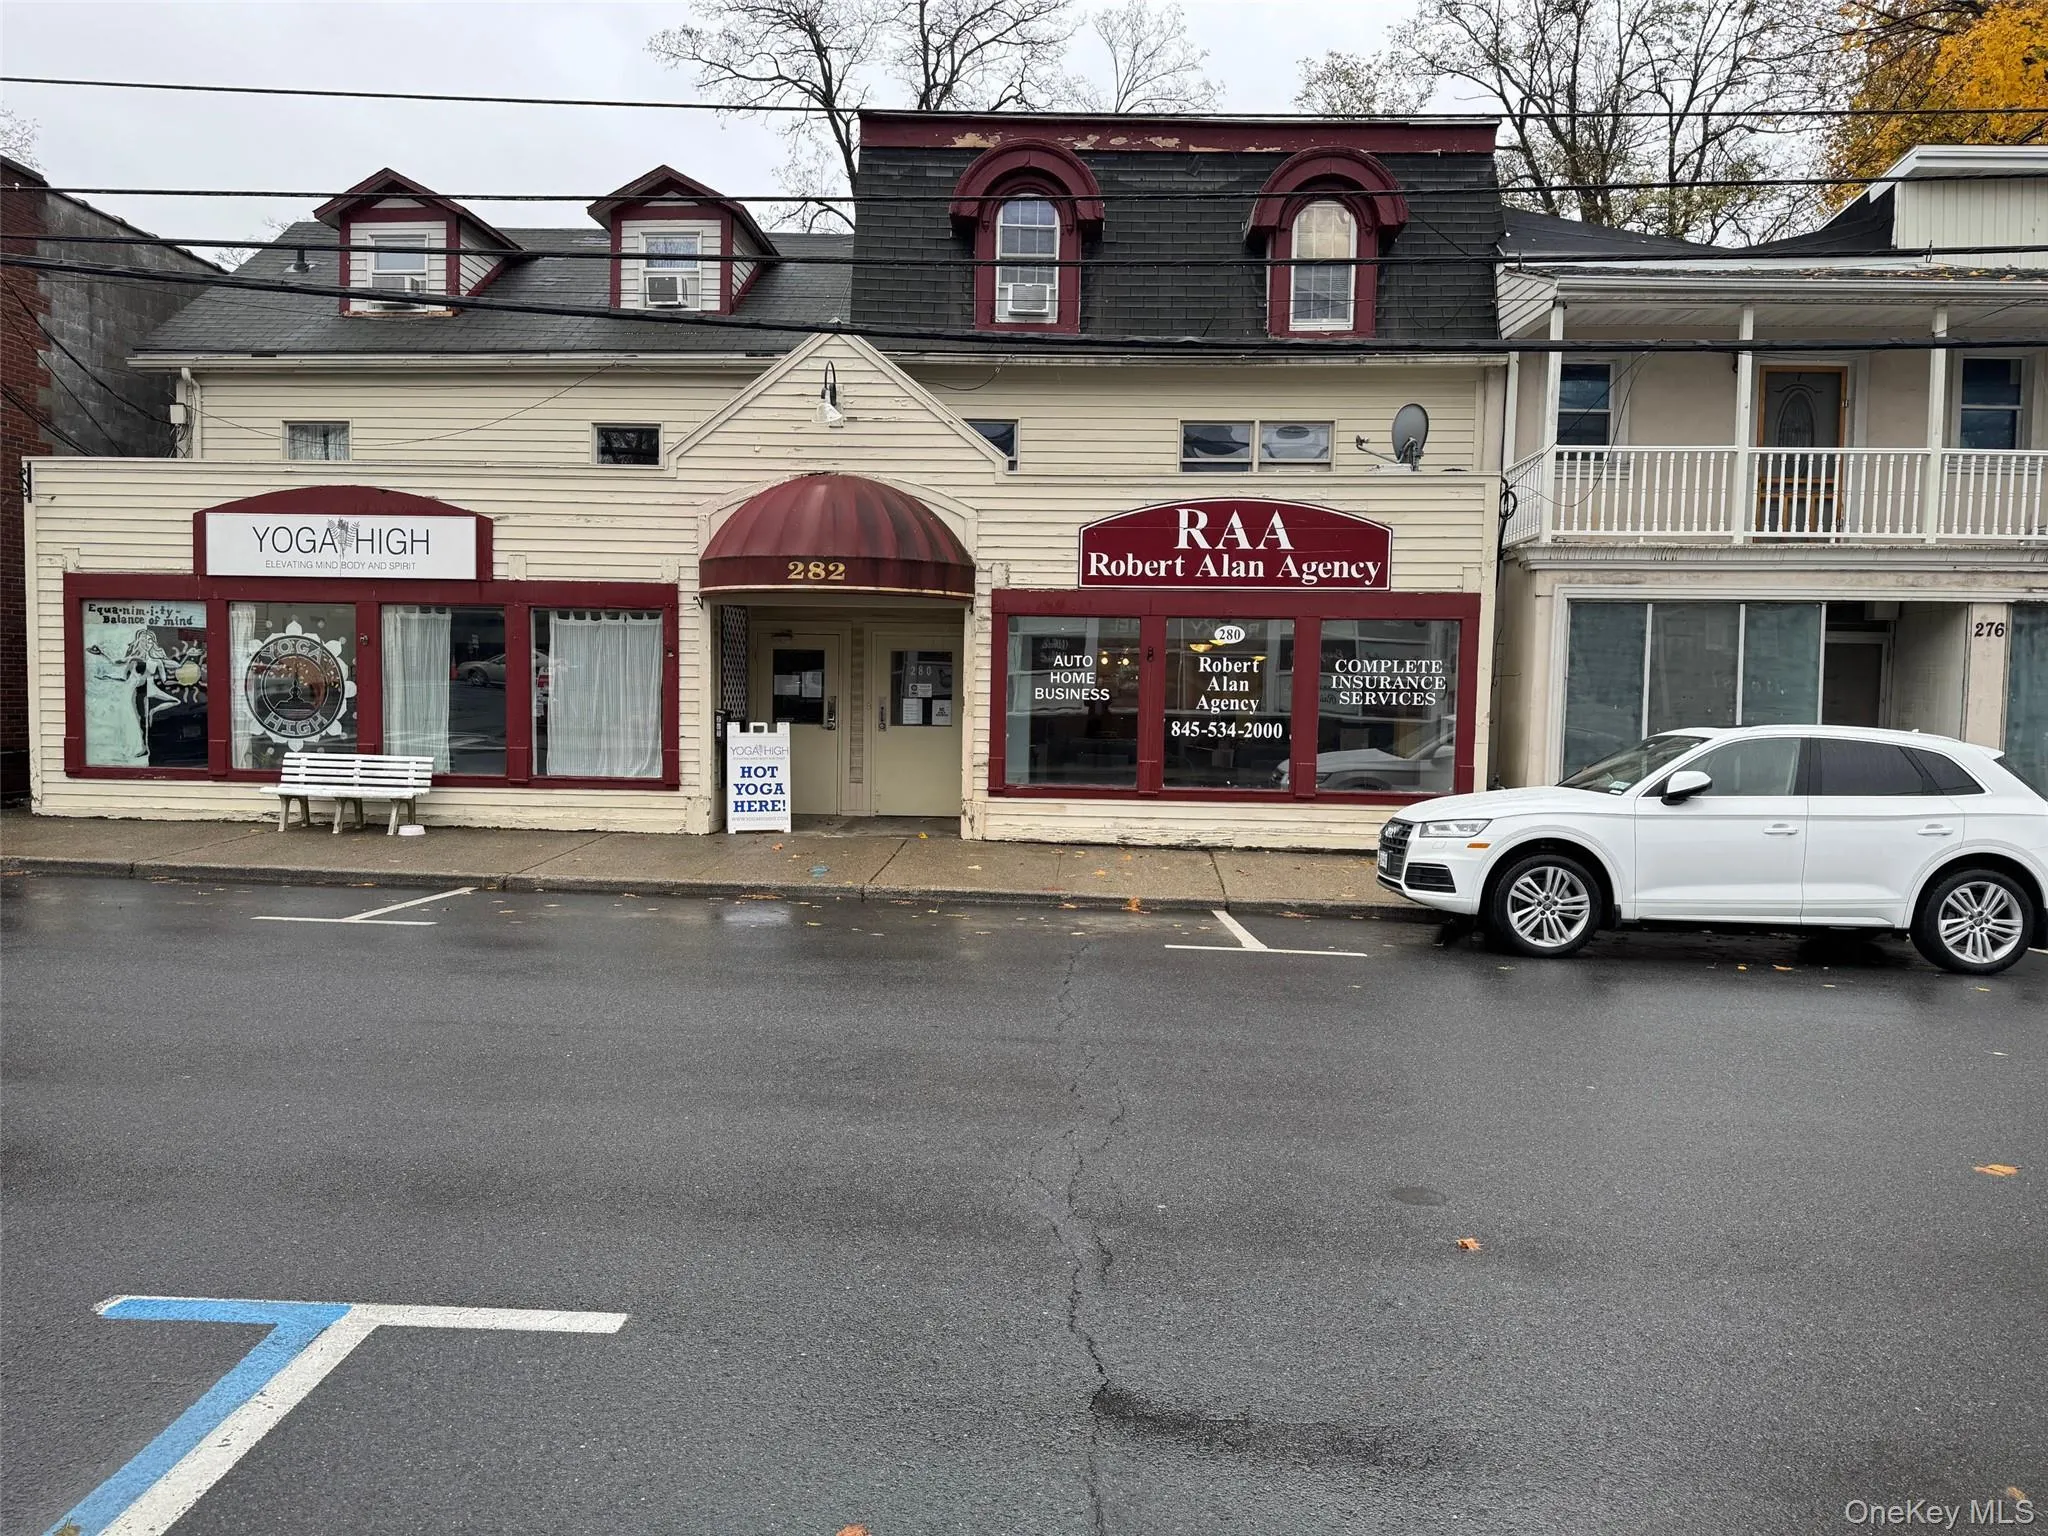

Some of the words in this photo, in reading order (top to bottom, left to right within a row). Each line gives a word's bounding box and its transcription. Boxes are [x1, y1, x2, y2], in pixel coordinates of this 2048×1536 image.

[1173, 508, 1294, 550] RAA
[252, 526, 338, 553] YOGA
[355, 528, 430, 555] HIGH
[265, 560, 313, 569] ELEVATING
[315, 561, 339, 570] MIND
[341, 561, 366, 571] BODY
[368, 562, 387, 570] AND
[389, 562, 416, 571] SPIRIT
[787, 561, 846, 581] 282
[1088, 552, 1185, 577] Robert
[1195, 553, 1265, 578] Alan
[1276, 554, 1382, 586] Agency
[102, 615, 145, 624] Balance
[148, 616, 160, 625] of
[163, 616, 193, 626] mind
[1219, 629, 1241, 640] 280
[1974, 622, 2005, 637] 276
[259, 640, 323, 663] YOGA
[1053, 655, 1094, 667] AUTO
[1198, 657, 1260, 673] Robert
[1335, 659, 1443, 674] COMPLETE
[911, 666, 932, 676] 280
[1050, 672, 1095, 684] HOME
[1207, 676, 1250, 692] Alan
[1331, 675, 1447, 690] INSURANCE
[1035, 688, 1110, 701] BUSINESS
[1339, 692, 1436, 706] SERVICES
[1196, 695, 1260, 715] Agency
[264, 711, 328, 735] HIGH
[1171, 721, 1283, 739] 845-534-2000
[730, 746, 760, 756] YOGA
[764, 746, 789, 756] HIGH
[740, 766, 779, 778] HOT
[733, 783, 786, 795] YOGA
[733, 800, 786, 812] HERE!
